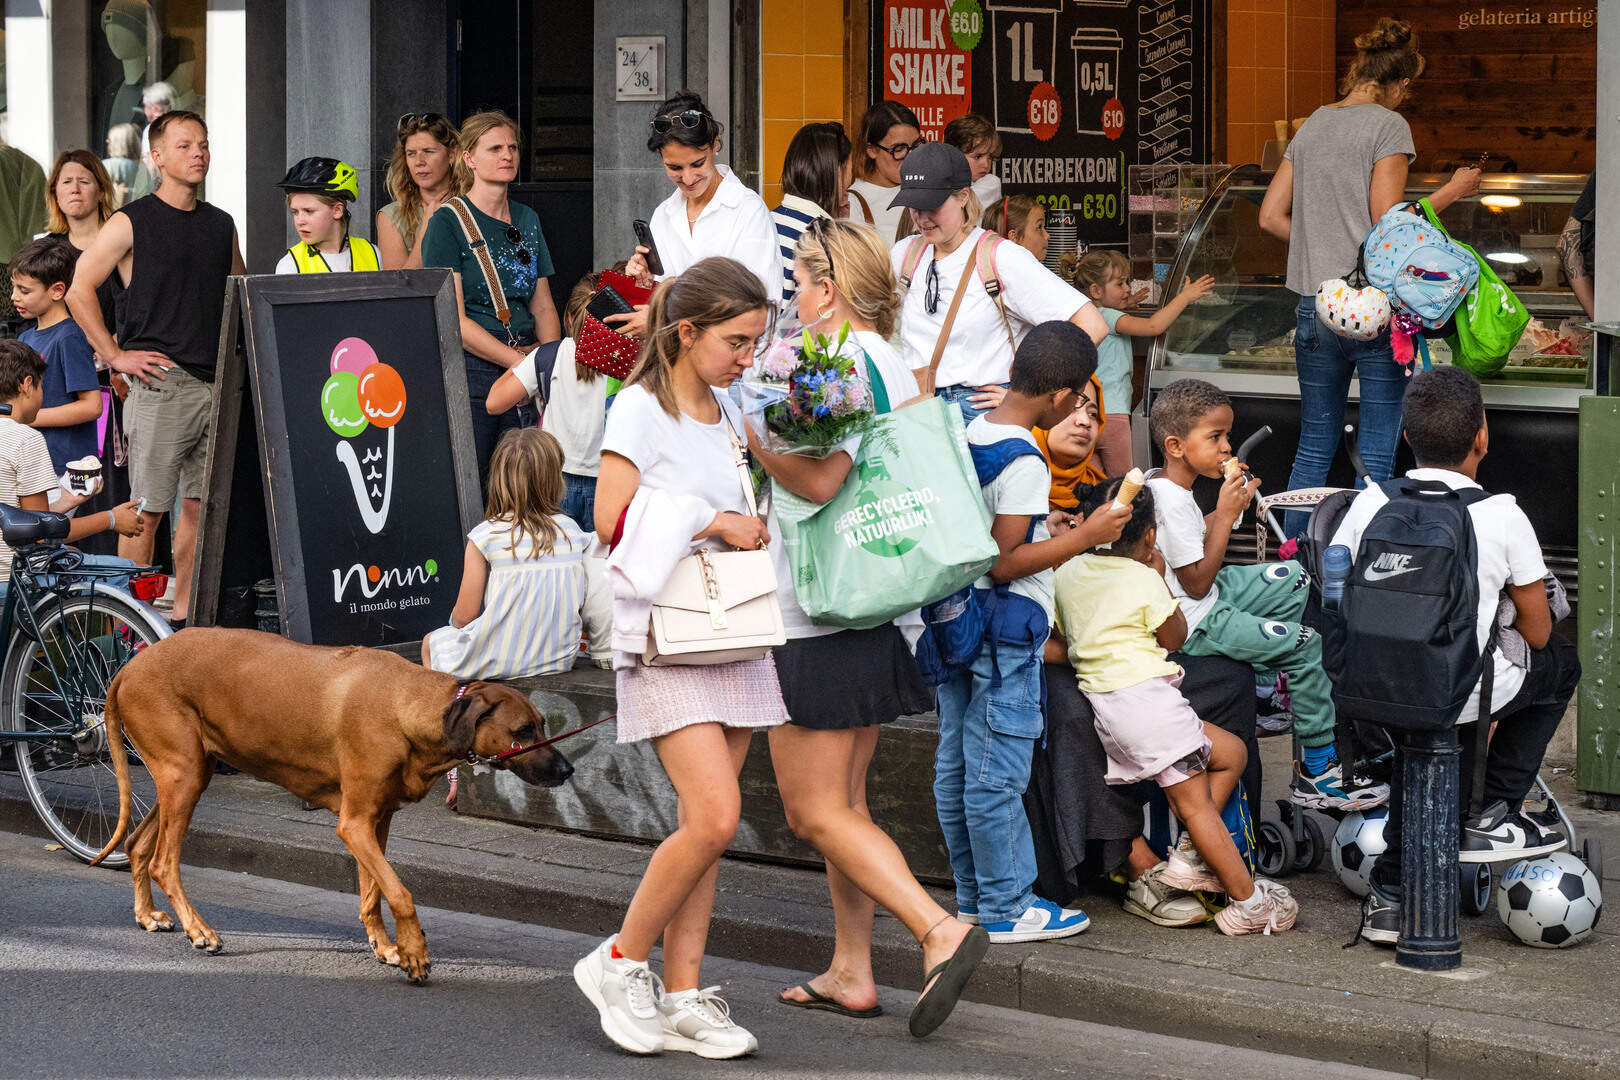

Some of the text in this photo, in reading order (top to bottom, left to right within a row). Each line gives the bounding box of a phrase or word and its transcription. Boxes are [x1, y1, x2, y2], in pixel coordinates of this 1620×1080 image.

[889, 7, 946, 49] MILK
[1458, 8, 1541, 30] gelateria
[622, 51, 636, 66] 24
[1006, 22, 1044, 81] 1L
[635, 71, 649, 87] 38
[889, 53, 965, 96] SHAKE
[1081, 62, 1114, 96] 0,5L
[1030, 99, 1058, 125] €18
[1103, 110, 1122, 128] €10
[843, 509, 935, 549] NATUURLIJK!
[1373, 552, 1413, 570] NIKE
[349, 595, 431, 614] il mondo gelato
[1502, 863, 1555, 883] OSMA
